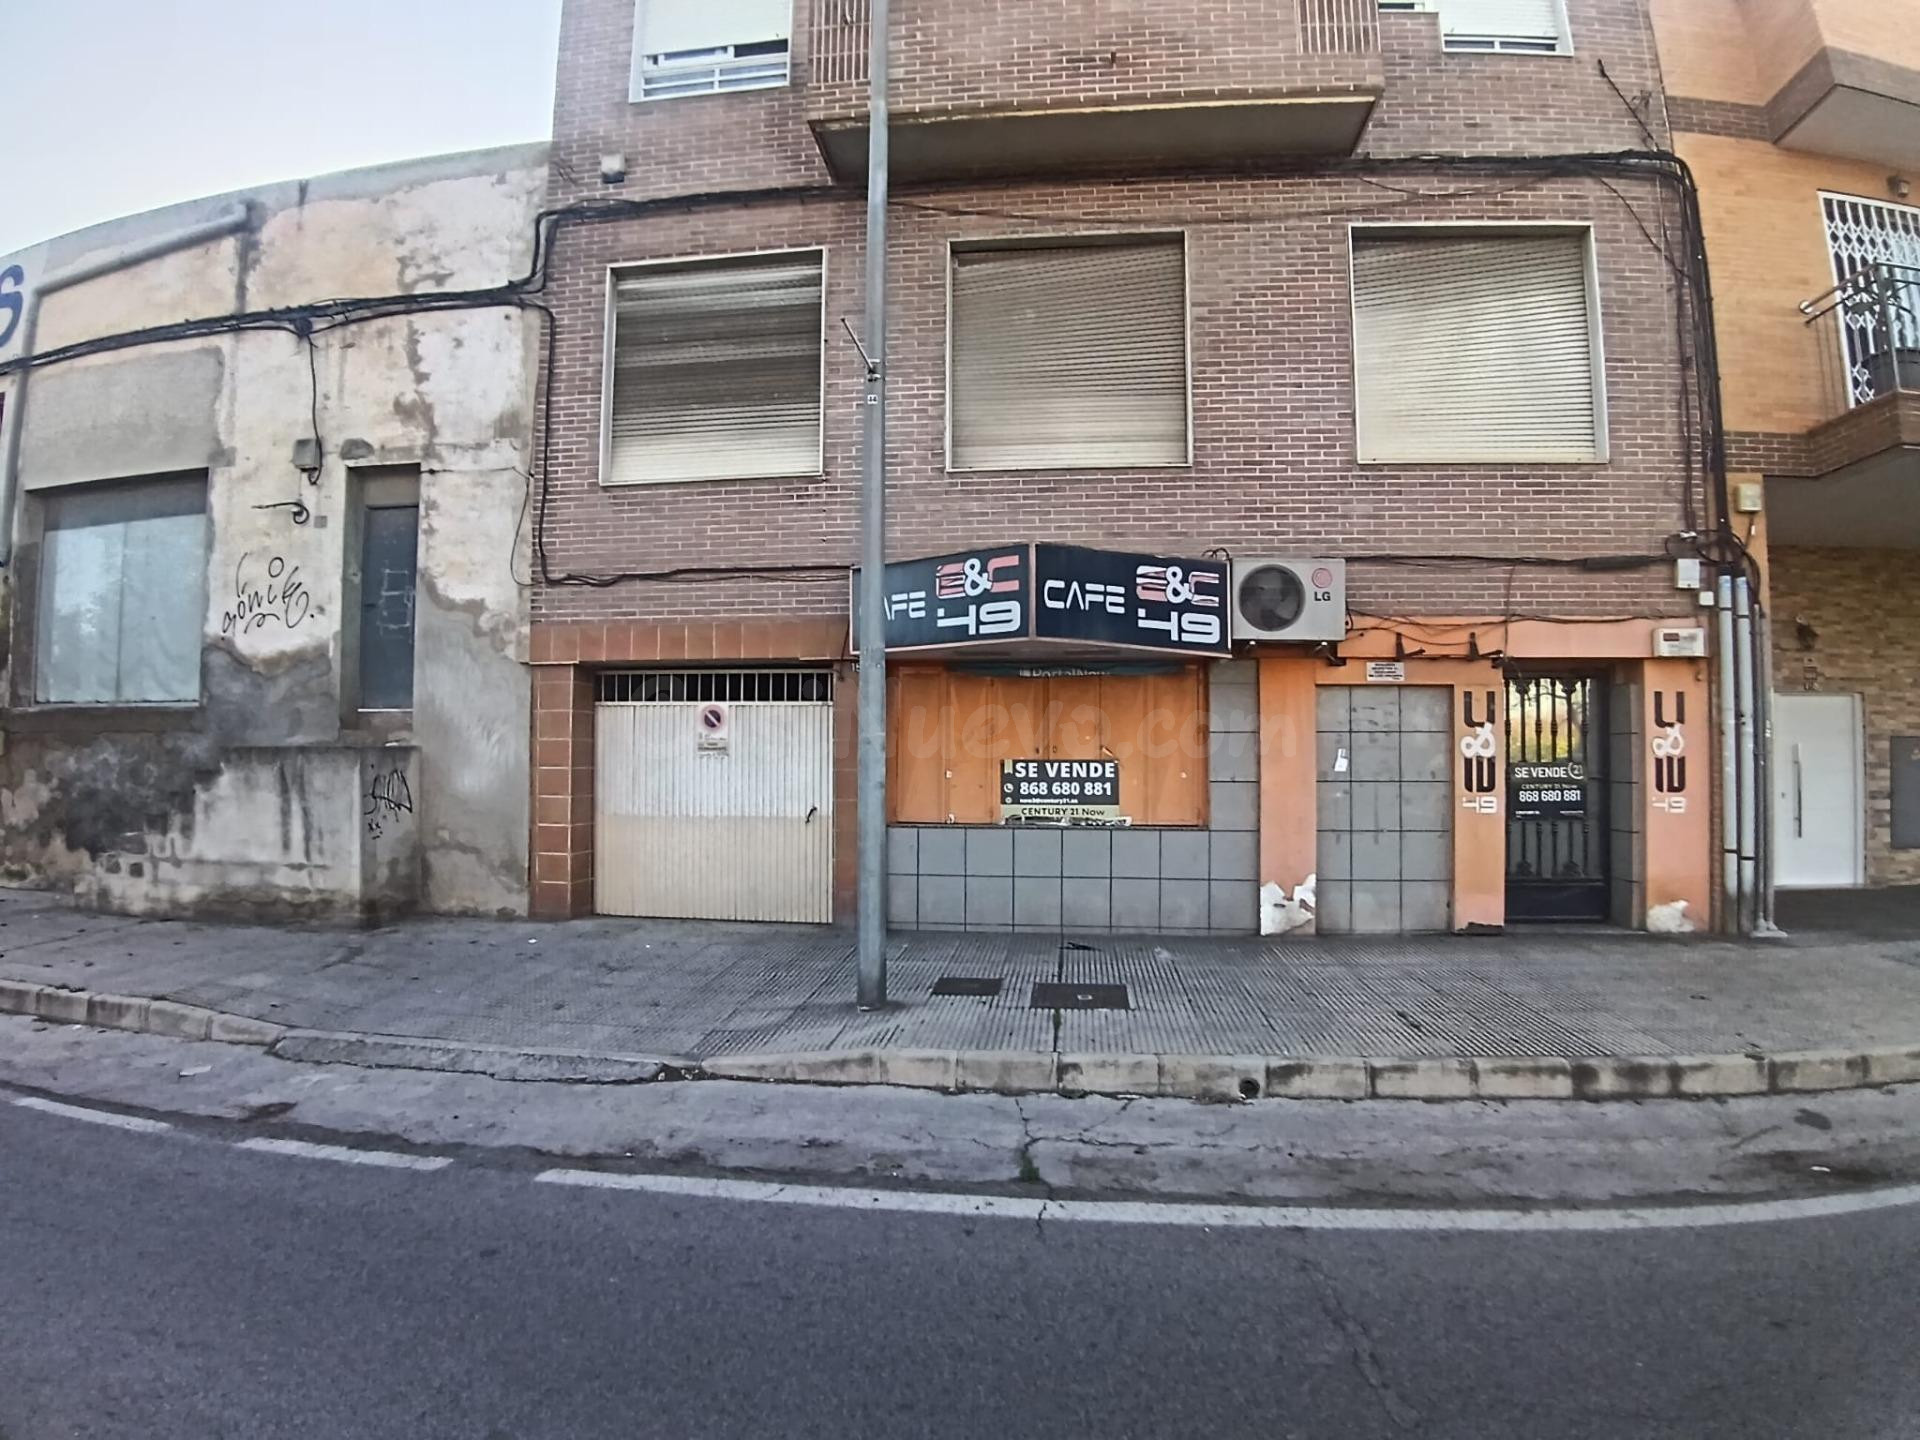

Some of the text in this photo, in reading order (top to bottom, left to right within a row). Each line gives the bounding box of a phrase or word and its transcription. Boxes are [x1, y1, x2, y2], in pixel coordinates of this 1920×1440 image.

[1044, 579, 1125, 614] CAFE
[1313, 590, 1331, 602] LG
[884, 590, 926, 621] FE
[937, 600, 1021, 636] 49
[1137, 607, 1221, 644] 49
[1015, 762, 1115, 778] SE VENDE
[1514, 767, 1529, 778] SE
[1530, 767, 1568, 778] VENDE
[1020, 782, 1111, 796] 868 680 881
[1519, 790, 1580, 802] 868 680 881
[1021, 807, 1105, 816] CENTURY 21 Now
[1462, 796, 1497, 814] 49
[1652, 796, 1686, 814] 49
